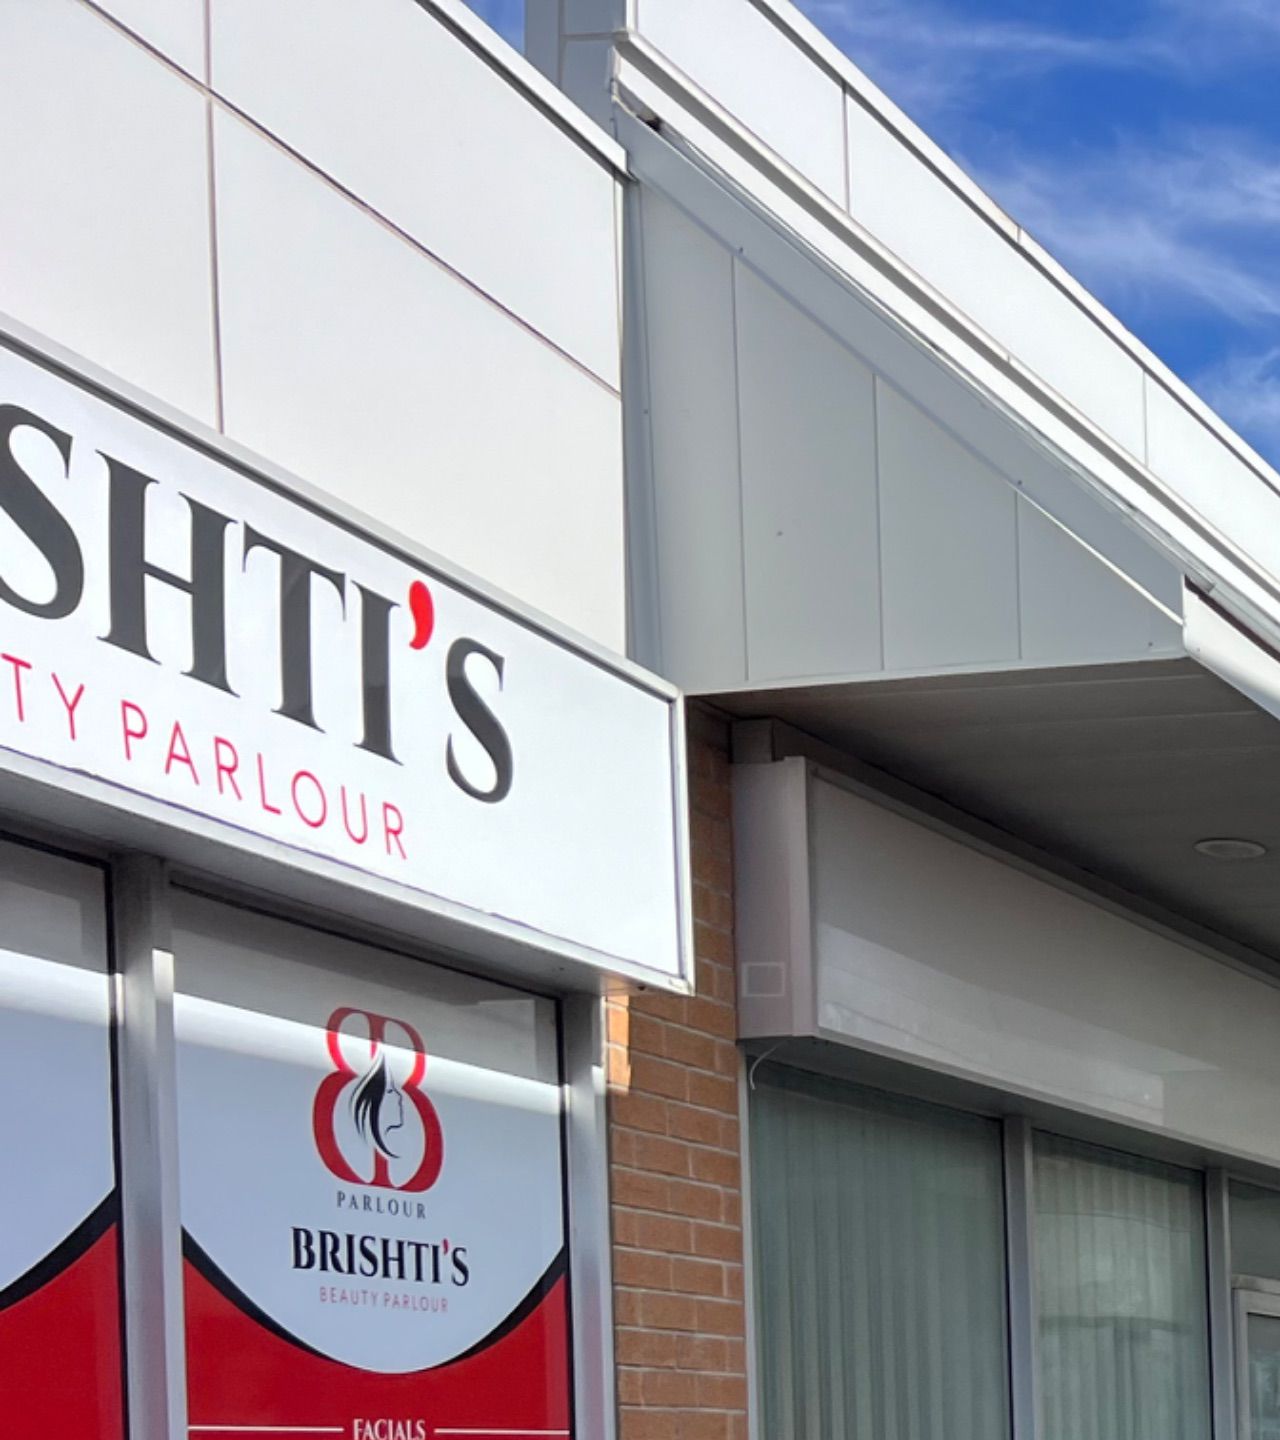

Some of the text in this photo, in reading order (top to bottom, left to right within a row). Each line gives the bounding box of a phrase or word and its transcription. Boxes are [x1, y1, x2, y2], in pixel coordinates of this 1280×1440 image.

[120, 700, 407, 860] PARLOUR
[336, 1191, 427, 1220] PARLOUR
[290, 1226, 470, 1287] BRISHTI'S
[319, 1286, 449, 1313] BEAUTY PARLOUR
